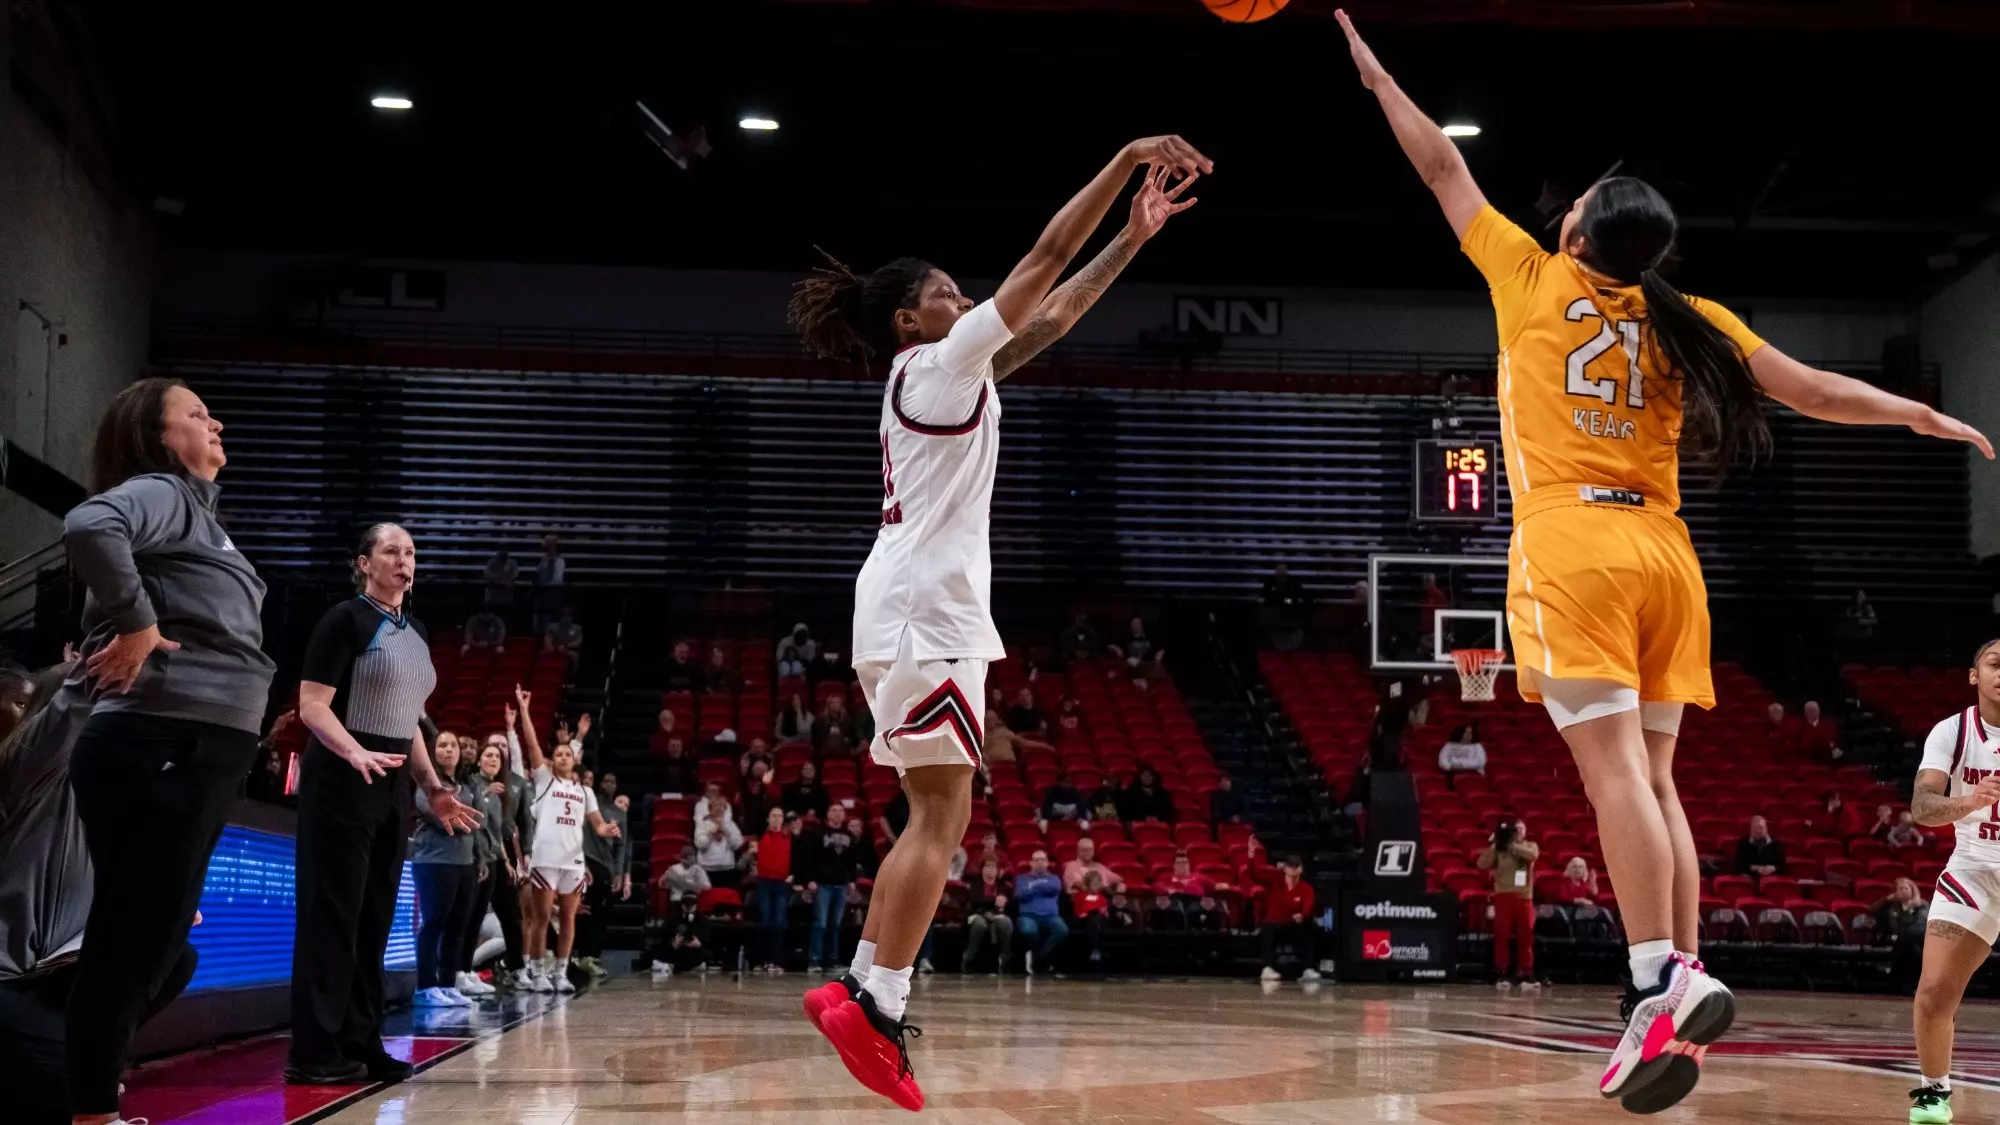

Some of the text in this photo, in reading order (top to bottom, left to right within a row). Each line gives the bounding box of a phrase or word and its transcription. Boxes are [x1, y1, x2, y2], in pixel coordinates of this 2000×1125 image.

[1178, 298, 1278, 334] NN
[1565, 297, 1645, 409] 21
[1446, 448, 1487, 472] 1:25
[1448, 473, 1479, 510] 17
[1963, 767, 2000, 785] ARK
[564, 801, 571, 815] 5
[556, 817, 575, 826] STATE
[1979, 822, 2000, 840] ST
